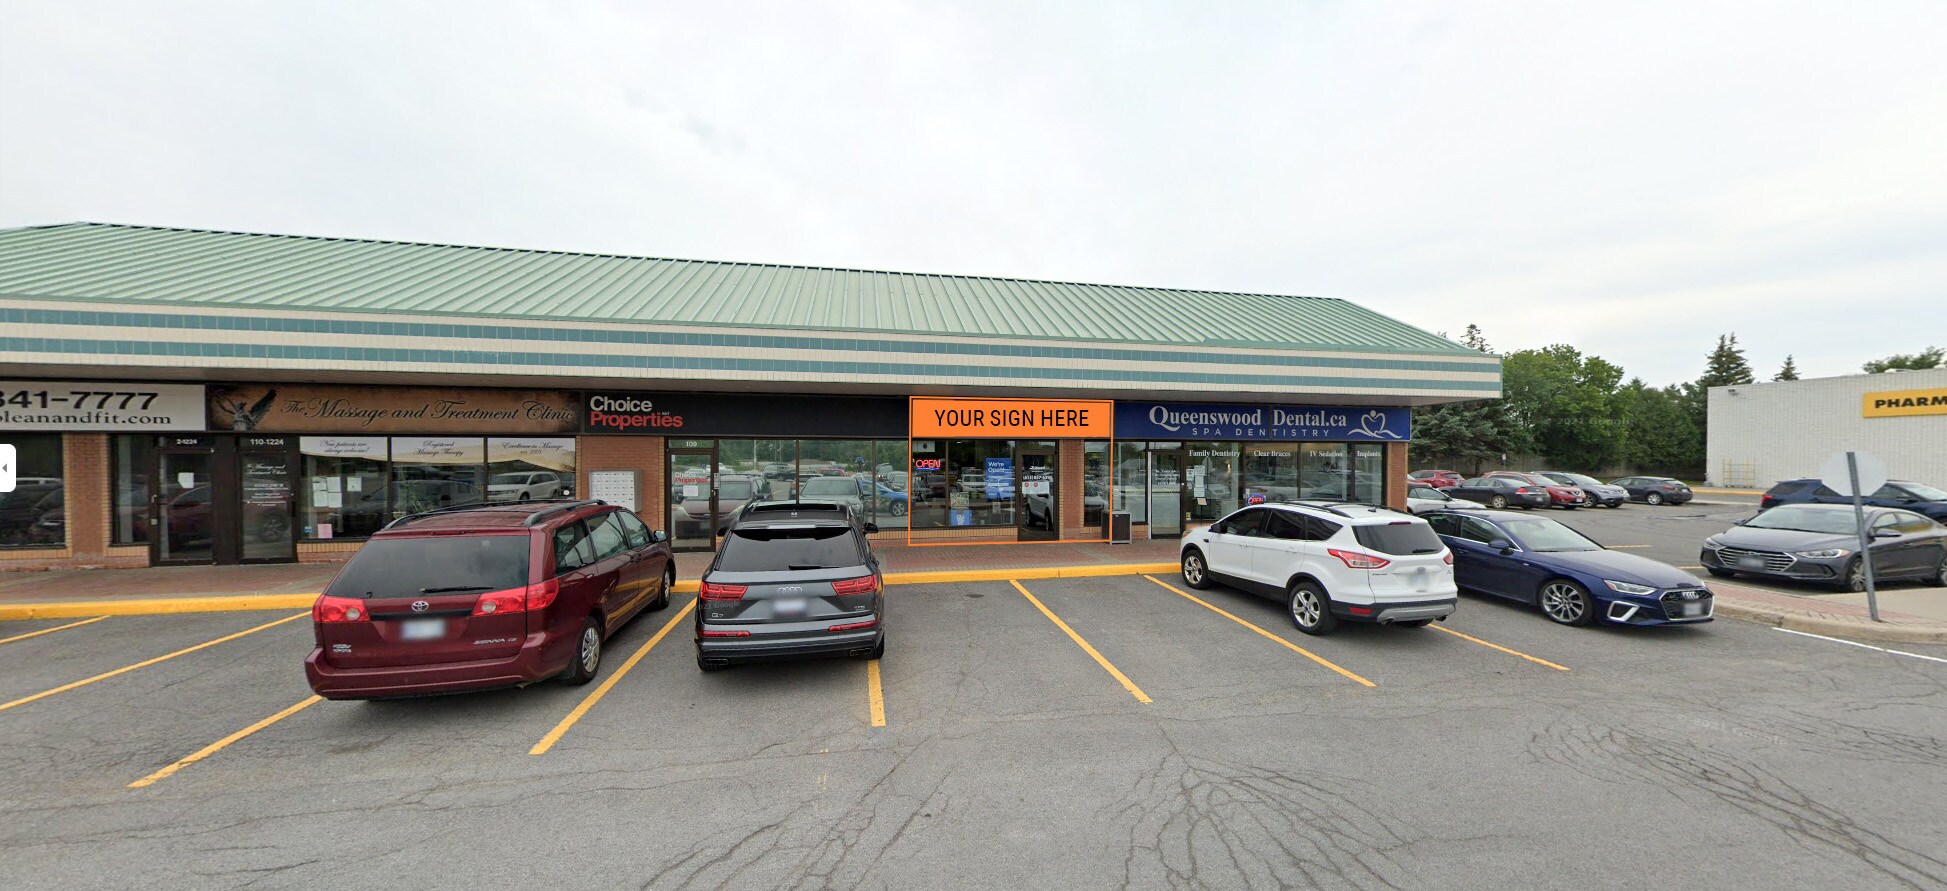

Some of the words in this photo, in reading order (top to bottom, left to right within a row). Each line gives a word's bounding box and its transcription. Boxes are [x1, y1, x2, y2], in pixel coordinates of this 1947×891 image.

[0, 390, 158, 410] 41-7777
[590, 395, 653, 412] Choice
[280, 398, 307, 414] The
[304, 397, 388, 427] Massage
[391, 403, 429, 420] and
[430, 400, 519, 421] Treatment
[521, 400, 575, 422] Clinic
[0, 411, 172, 424] leanandfit.com
[590, 411, 684, 430] Properties
[1149, 405, 1262, 432] Queenswood
[1273, 408, 1347, 427] Dental.ca
[1192, 427, 1222, 436] SPA
[1235, 427, 1330, 437] DENTISTRY
[250, 438, 284, 446] 110-1224
[423, 440, 454, 449] Registered
[502, 441, 531, 449] Excellence
[538, 441, 564, 450] Massage
[412, 448, 440, 456] Massage
[443, 448, 464, 456] Therapy
[1188, 449, 1211, 457] Family
[1211, 449, 1240, 458] Dentistry
[1357, 450, 1381, 458] Implants
[915, 459, 941, 468] OPEN
